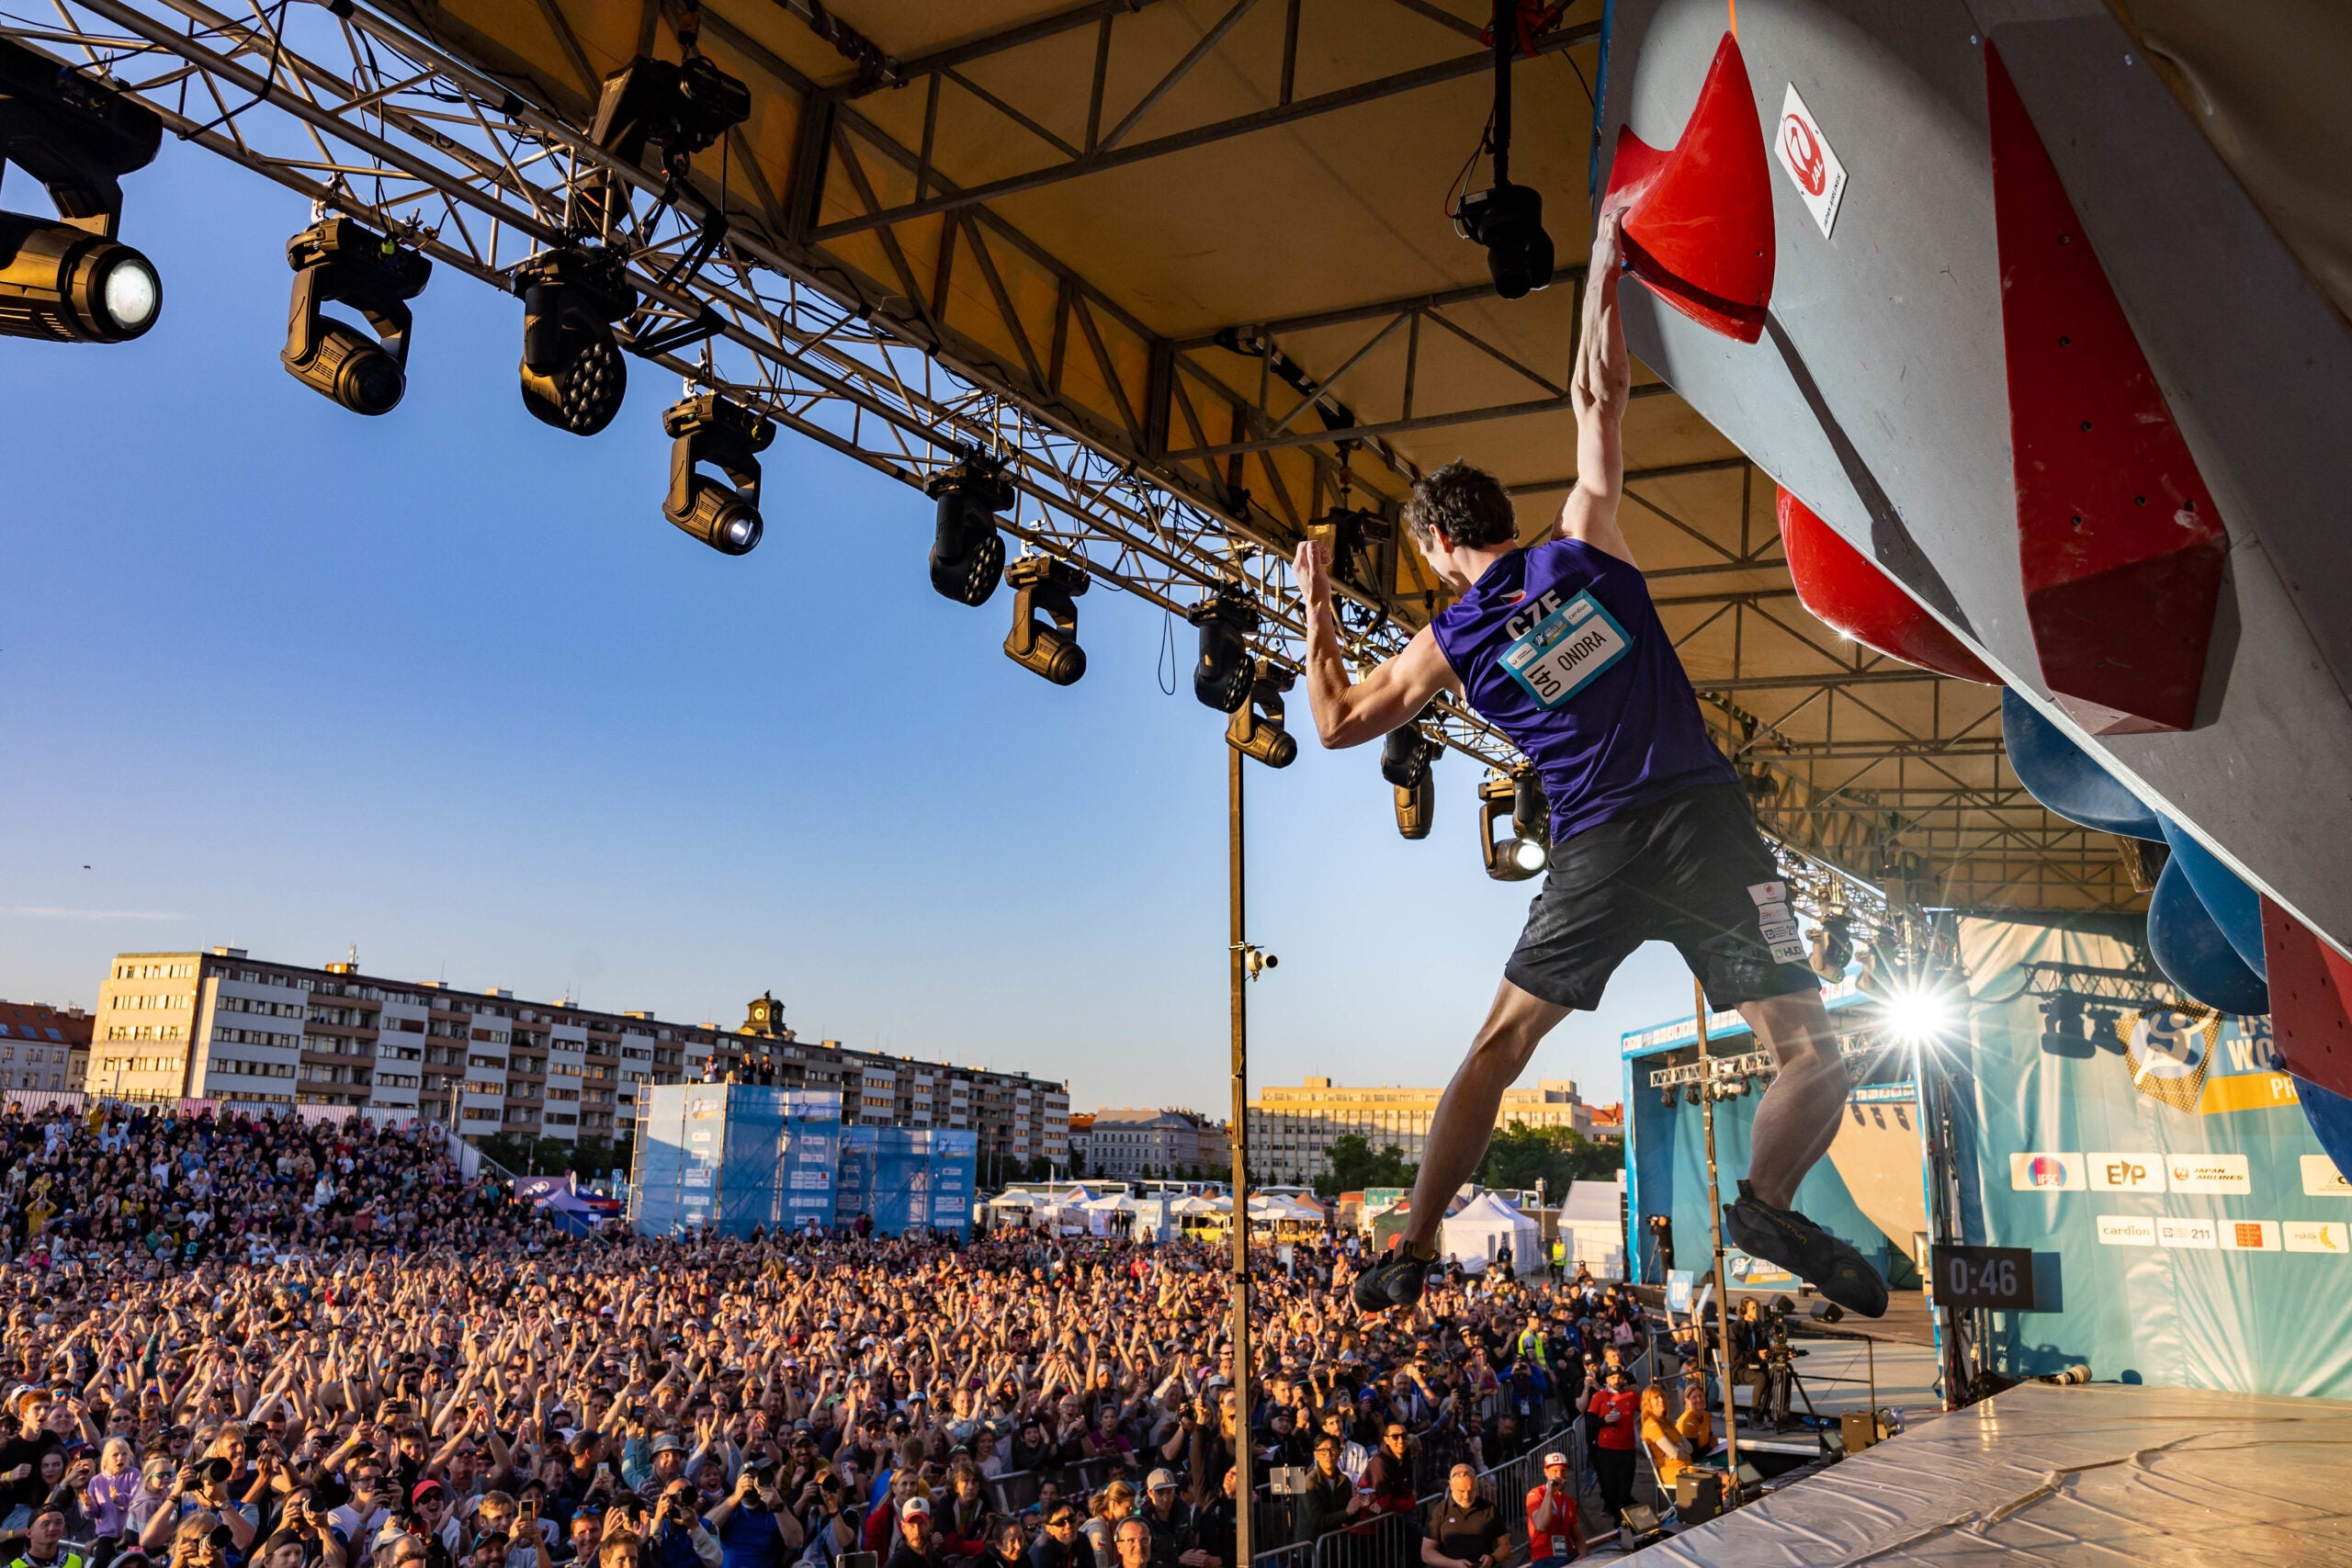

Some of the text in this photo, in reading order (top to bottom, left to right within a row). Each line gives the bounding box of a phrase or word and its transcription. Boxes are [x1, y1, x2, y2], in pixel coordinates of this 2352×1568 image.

[1811, 158, 1824, 191] JAL
[1824, 173, 1841, 230] JAPAN AIRLINES
[1568, 604, 1589, 620] cardion
[1557, 630, 1607, 671] ONDRA
[1528, 664, 1561, 698] 041
[2036, 1173, 2059, 1186] IFSC
[2103, 1225, 2150, 1236] cardion
[2190, 1229, 2211, 1239] 211
[2294, 1232, 2317, 1240] rohlik
[1950, 1258, 2018, 1296] 0:46
[1671, 1282, 1689, 1301] TOP
